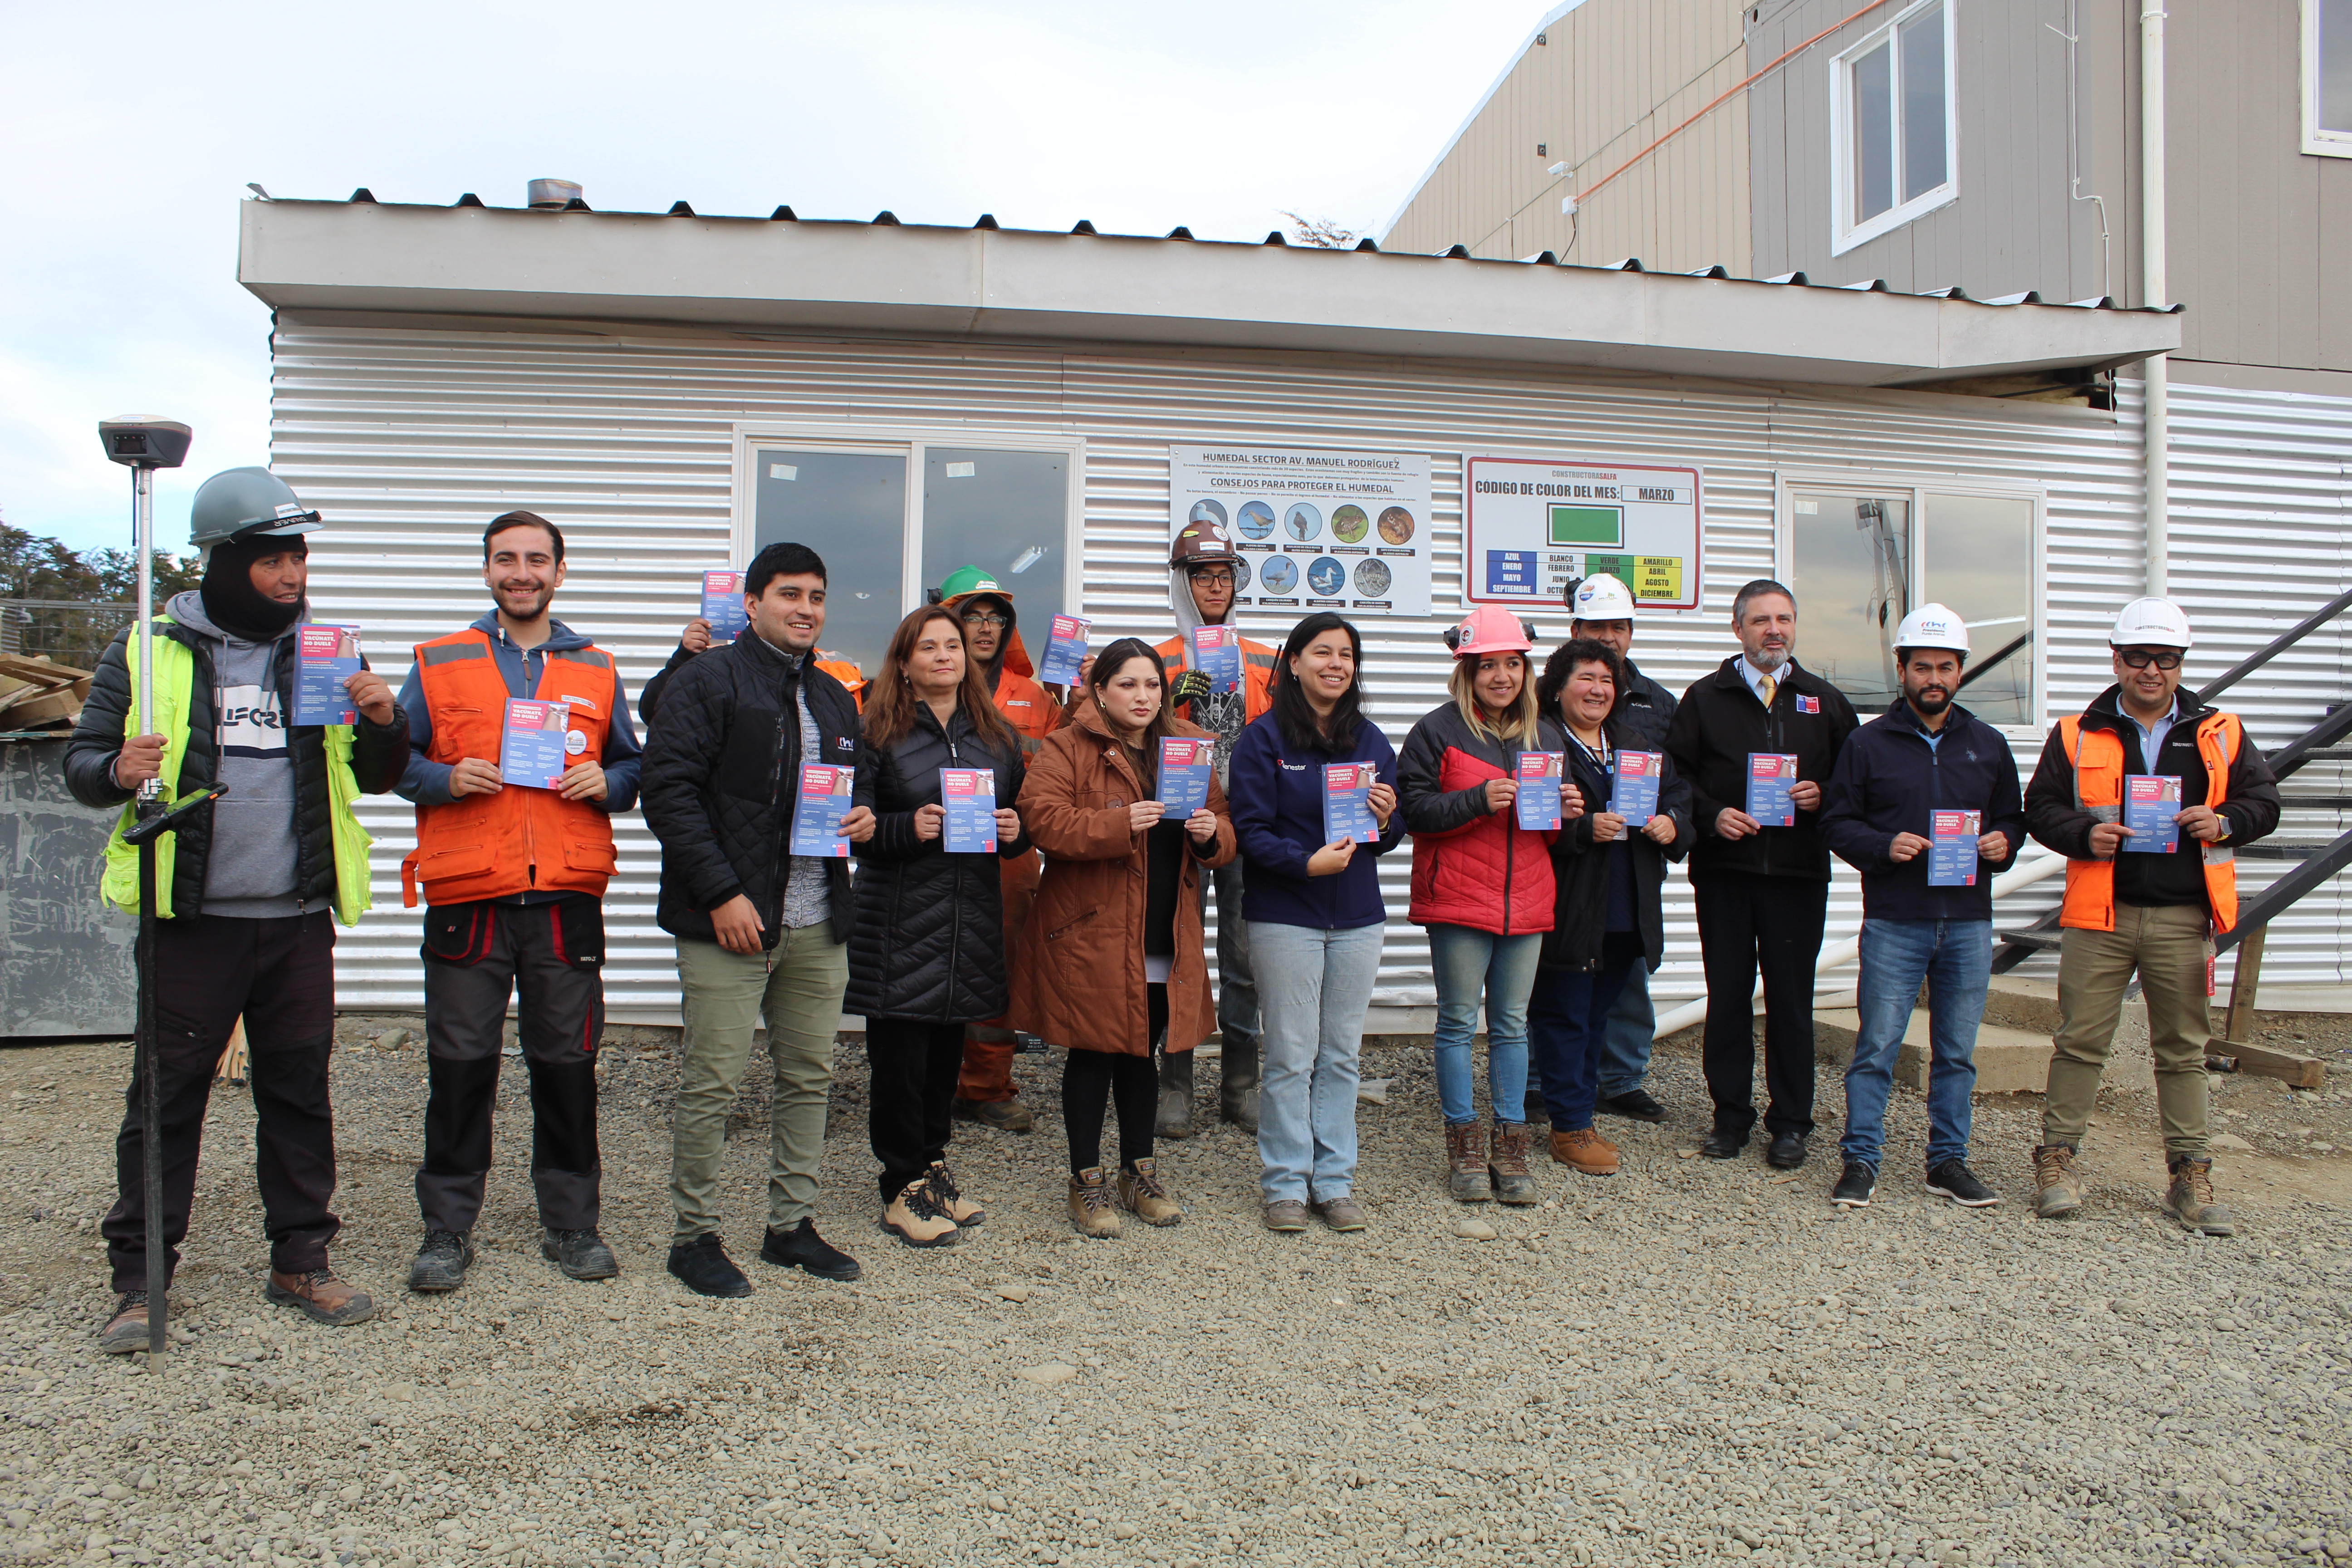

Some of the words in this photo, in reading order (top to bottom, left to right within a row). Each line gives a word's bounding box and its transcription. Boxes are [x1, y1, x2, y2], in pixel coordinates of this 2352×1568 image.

[1203, 453, 1250, 462] HUMEDAL
[1253, 455, 1287, 464] SECTOR
[1289, 456, 1304, 465] AV.
[1307, 457, 1346, 466] MANUEL
[1348, 457, 1400, 469] RODRÍGUEZ
[1210, 478, 1259, 487] CONSEJOS
[1262, 480, 1286, 488] PARA
[1288, 481, 1334, 490] PROTEGER
[1349, 484, 1394, 492] HUMEDAL
[1475, 479, 1517, 495] CÓDIGO
[1520, 483, 1533, 495] DE
[1536, 484, 1571, 497] COLOR
[1574, 485, 1591, 498] DEL
[1595, 486, 1619, 499] MES:
[1639, 488, 1674, 501] MARZO
[1504, 553, 1520, 561] AZUL
[1600, 557, 1619, 565] VERDE
[1643, 558, 1672, 566] AMARILLO
[1502, 563, 1522, 571] ENERO
[1599, 566, 1620, 574] MARZO
[1648, 567, 1666, 575] ABRIL
[1503, 574, 1521, 582] MAYO
[1552, 575, 1569, 583] JUNIO
[1645, 578, 1669, 587] AGOSTO
[1492, 584, 1531, 593] SEPTIEMBRE
[1641, 589, 1673, 598] DICIEMBRE
